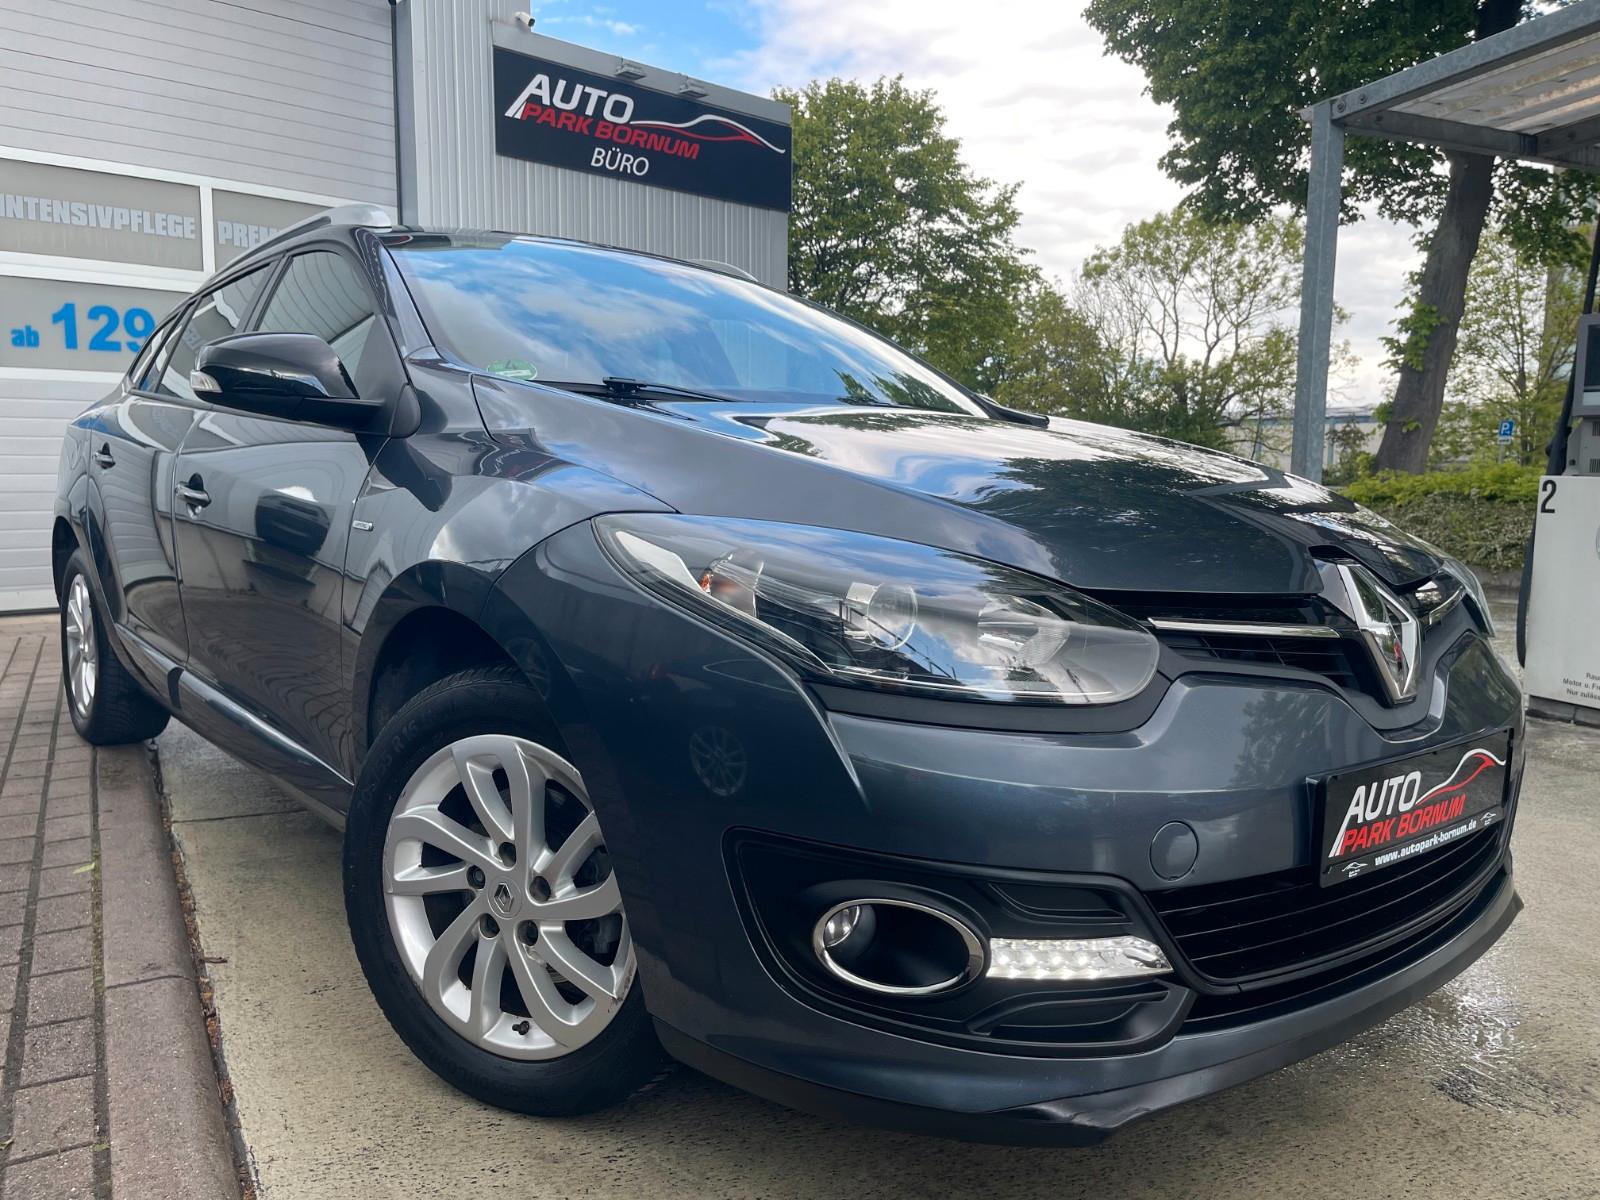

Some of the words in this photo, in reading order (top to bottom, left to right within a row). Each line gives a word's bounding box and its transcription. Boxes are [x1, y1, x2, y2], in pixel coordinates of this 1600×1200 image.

[504, 73, 635, 124] AUTO
[521, 102, 591, 136] PARK
[594, 122, 700, 160] BORNUM
[590, 147, 649, 176] BÜRO
[0, 192, 196, 240] INTENSIVPFLEGE
[10, 325, 40, 348] ab
[51, 302, 155, 353] 129
[1501, 422, 1511, 435] P
[1540, 479, 1557, 514] 2
[1328, 770, 1422, 858] AUTO
[1339, 817, 1399, 856] PARK
[1396, 794, 1467, 839] BORNUM
[1374, 818, 1477, 867] www.autopark-bornum.de
